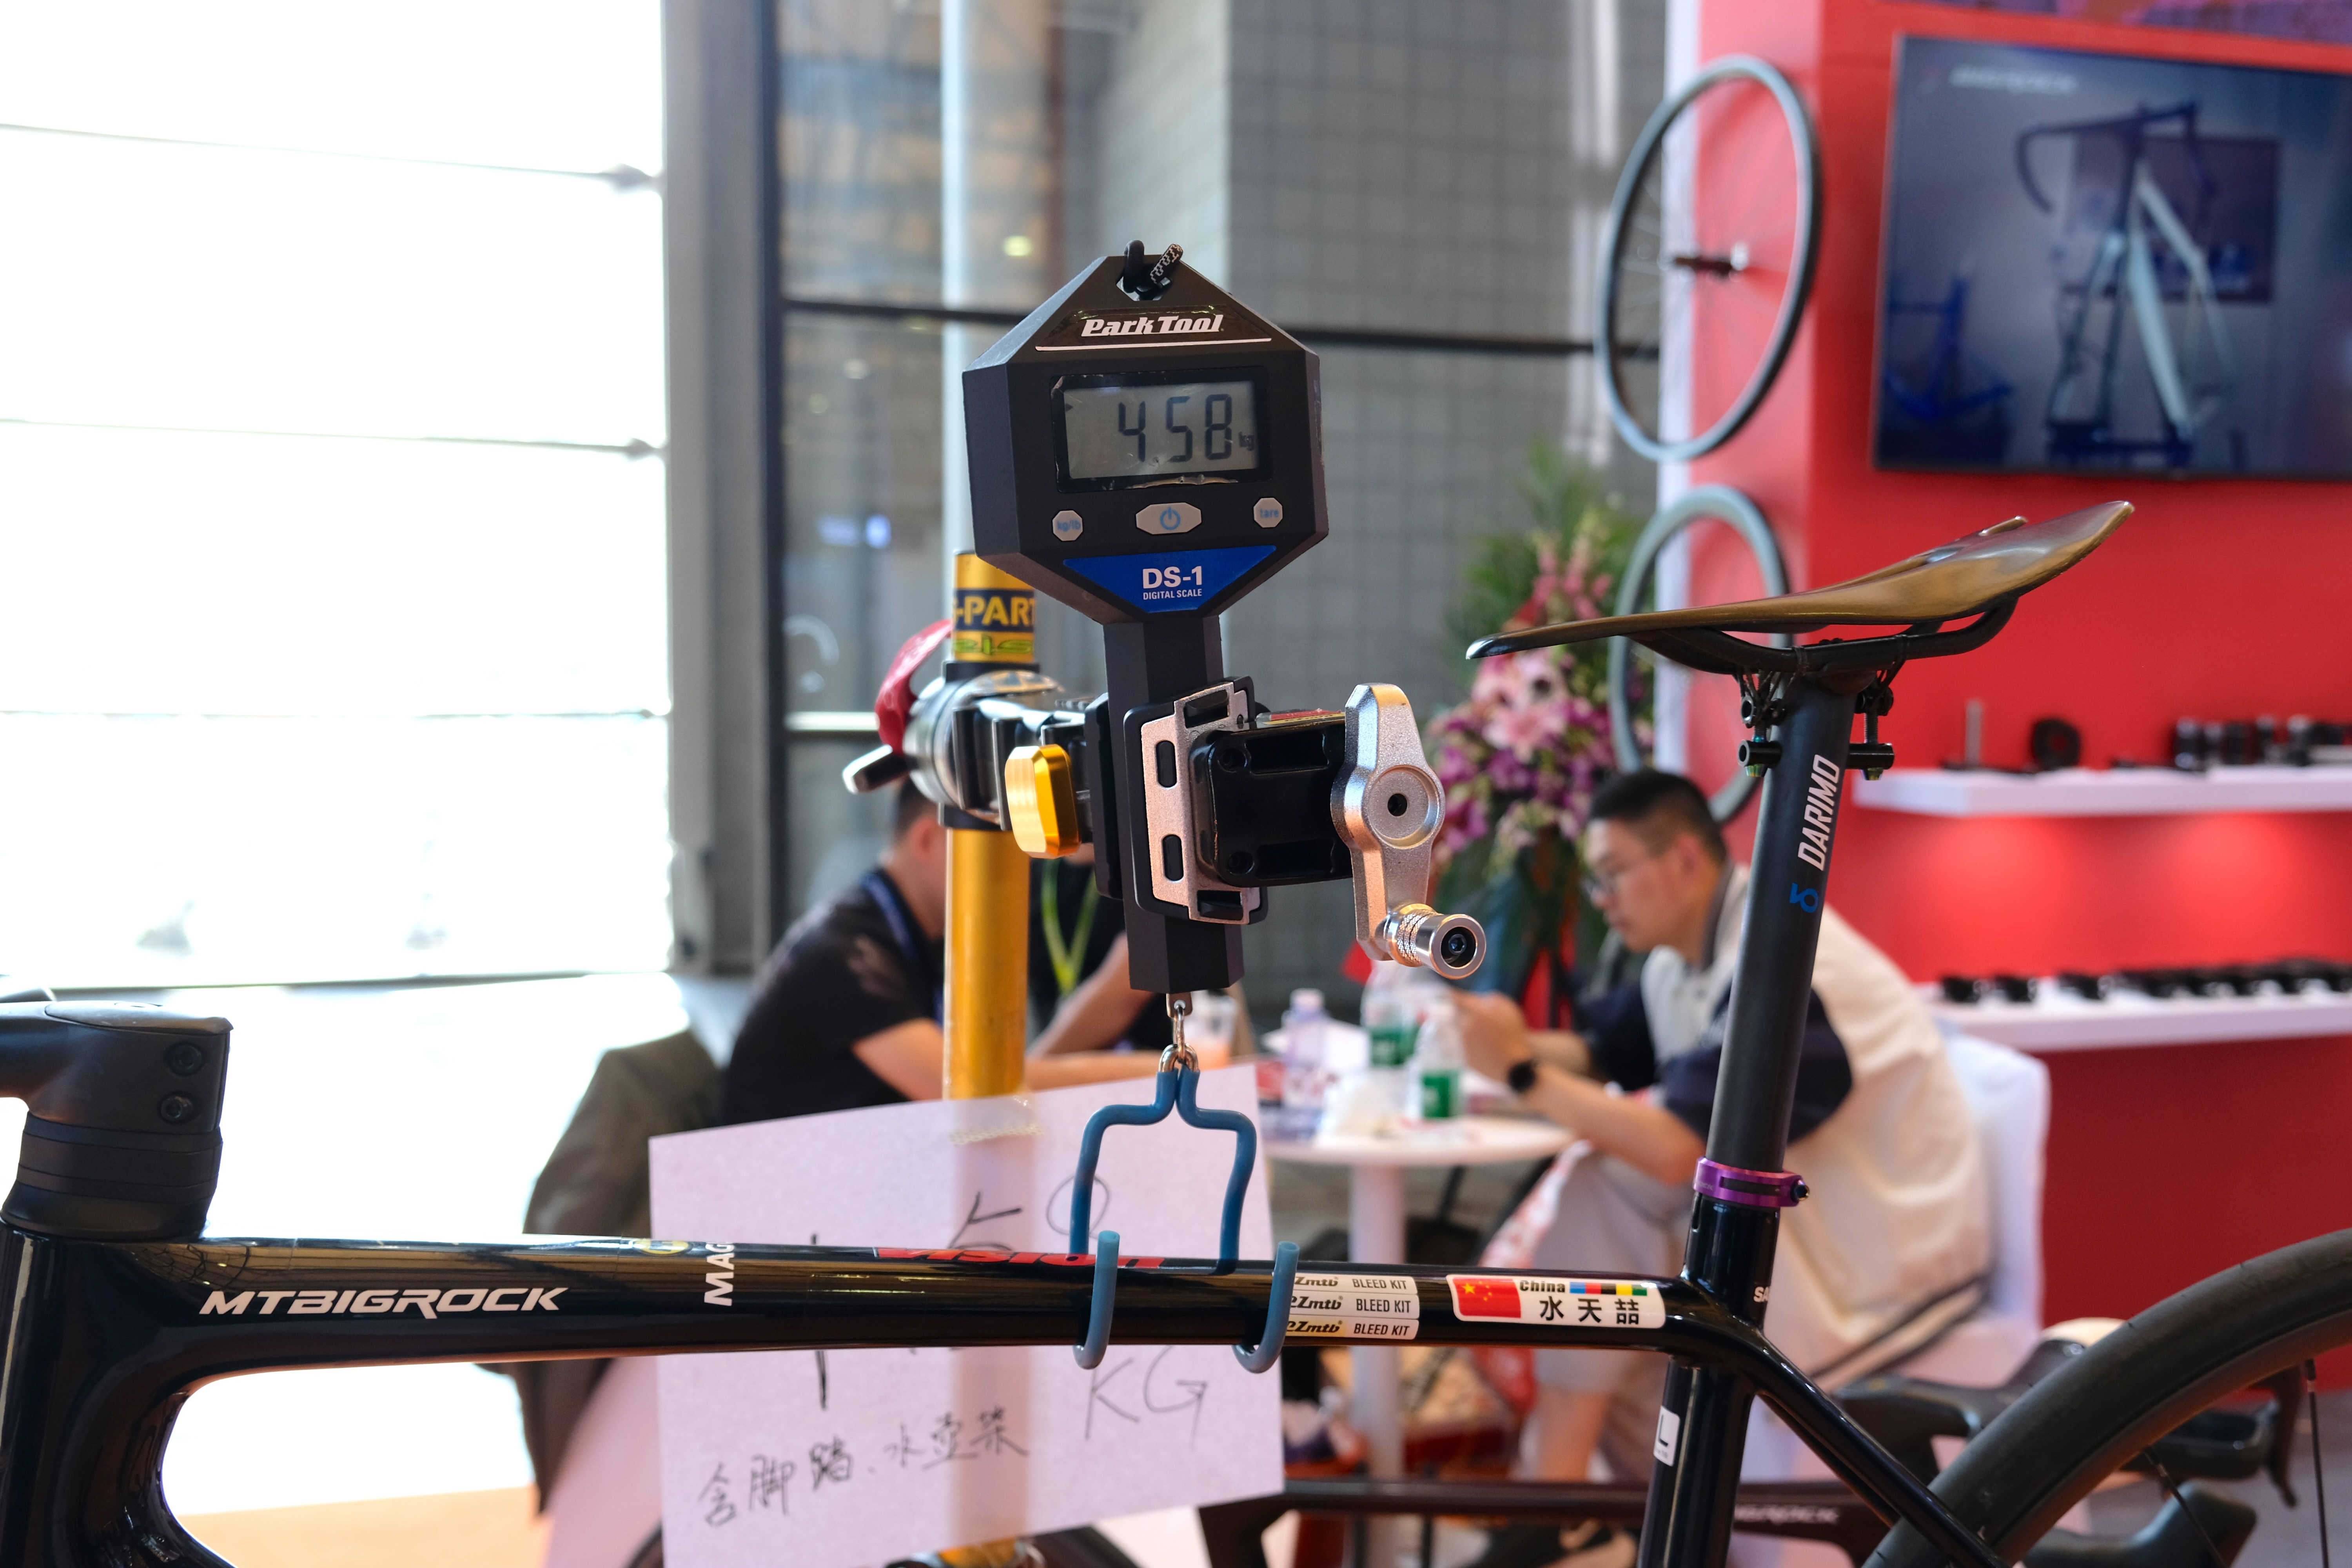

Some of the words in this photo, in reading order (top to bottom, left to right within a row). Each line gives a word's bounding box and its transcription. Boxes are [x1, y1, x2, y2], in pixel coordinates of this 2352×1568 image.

[1081, 317, 1154, 337] Park
[1157, 314, 1224, 334] Tool
[1239, 432, 1254, 451] kg
[1259, 508, 1279, 518] tare
[1143, 566, 1202, 589] DS-1
[1143, 591, 1175, 600] DIGITAL
[1176, 588, 1202, 598] SCALE
[1798, 754, 1840, 871] DARIMO
[1294, 1277, 1338, 1286] Zmtb
[1352, 1279, 1387, 1289] BLEED
[1390, 1280, 1406, 1290] KIT
[1520, 1280, 1565, 1293] China
[199, 1287, 568, 1319] MTBIGROCK
[1356, 1299, 1390, 1312] BLEED
[1394, 1300, 1411, 1313] KIT
[1539, 1296, 1639, 1325] 水天喆
[1354, 1323, 1388, 1335] BLEED
[1391, 1325, 1410, 1336] KIT
[1083, 1345, 1208, 1451] KG
[1658, 1415, 1668, 1447] L
